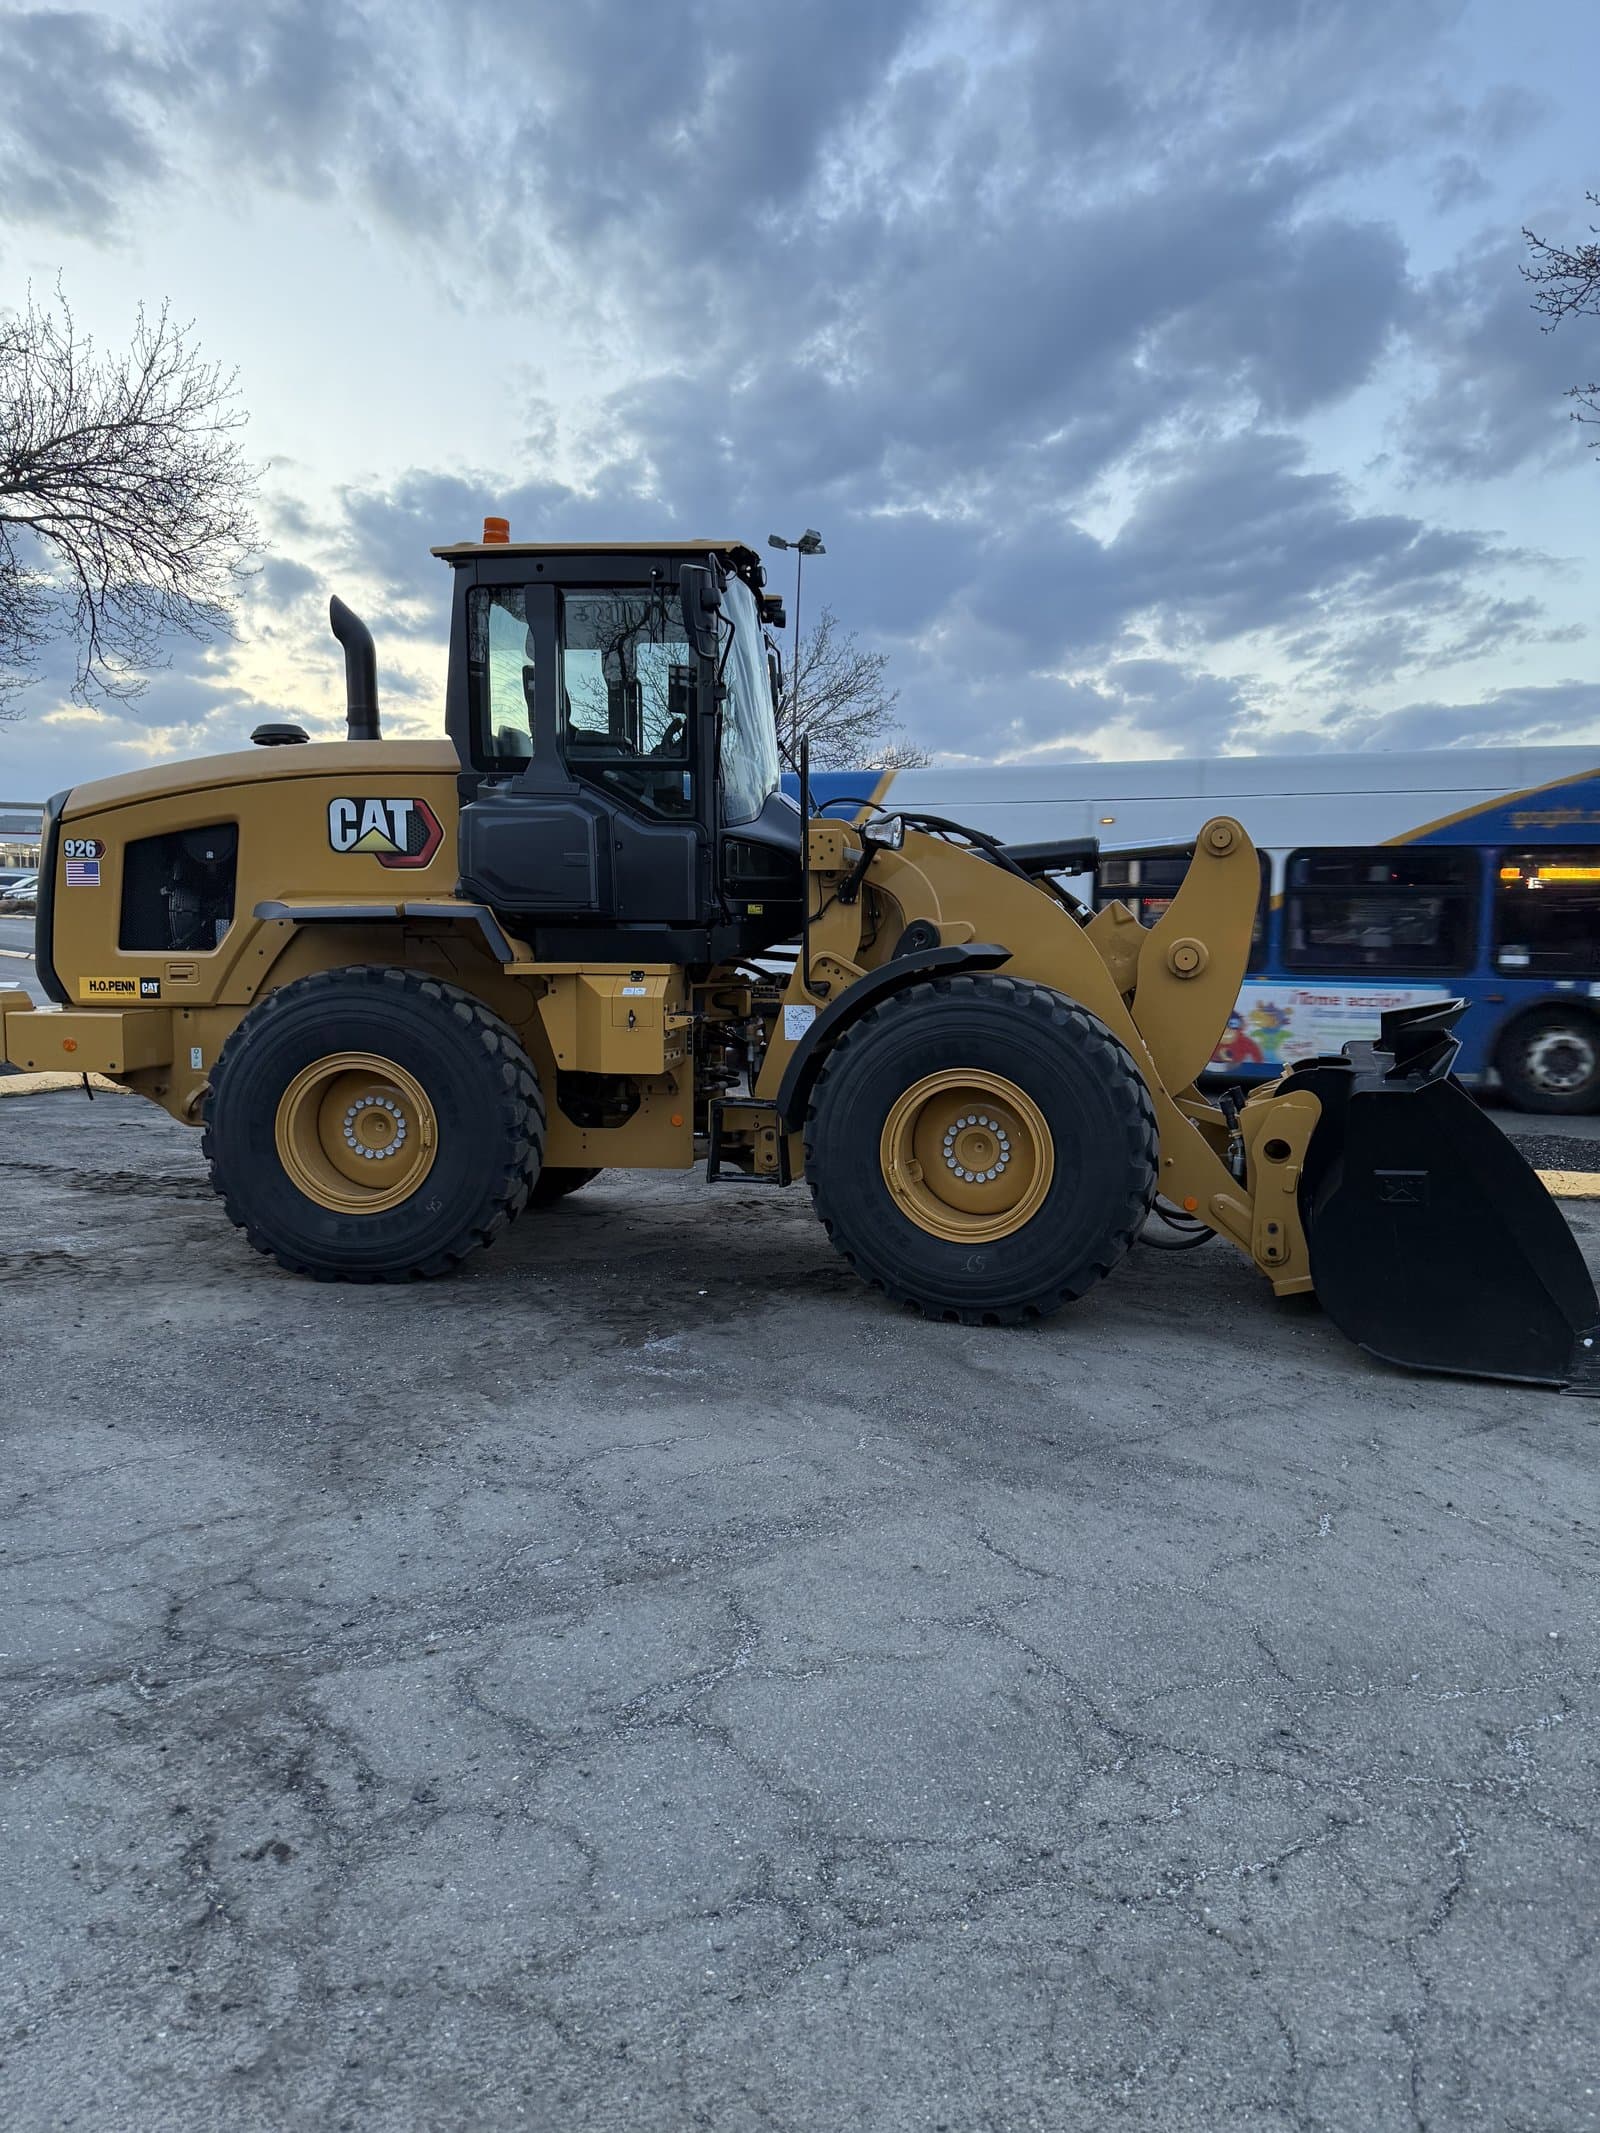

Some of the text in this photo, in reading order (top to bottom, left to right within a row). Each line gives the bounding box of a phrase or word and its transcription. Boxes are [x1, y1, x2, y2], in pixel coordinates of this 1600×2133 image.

[329, 798, 413, 852] CAT
[64, 839, 97, 858] 926
[141, 982, 159, 994] CAT
